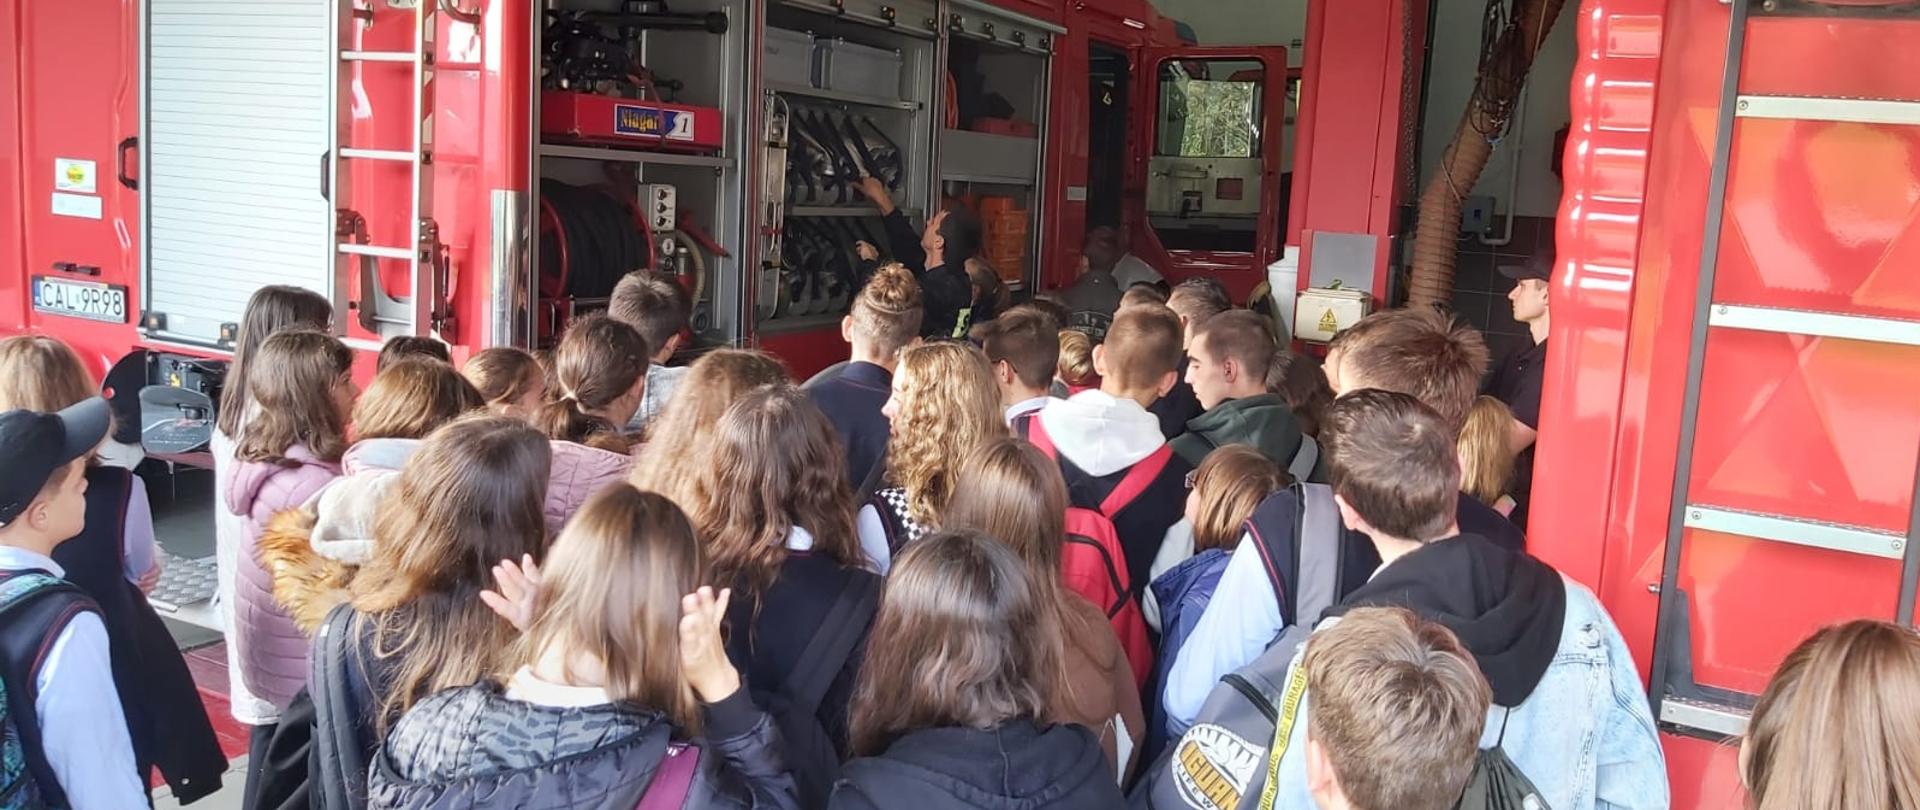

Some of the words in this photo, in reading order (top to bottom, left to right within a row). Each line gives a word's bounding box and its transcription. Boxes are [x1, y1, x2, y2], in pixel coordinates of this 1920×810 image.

[682, 117, 689, 133] 1
[43, 283, 75, 310] CAL
[81, 288, 122, 316] 9R98
